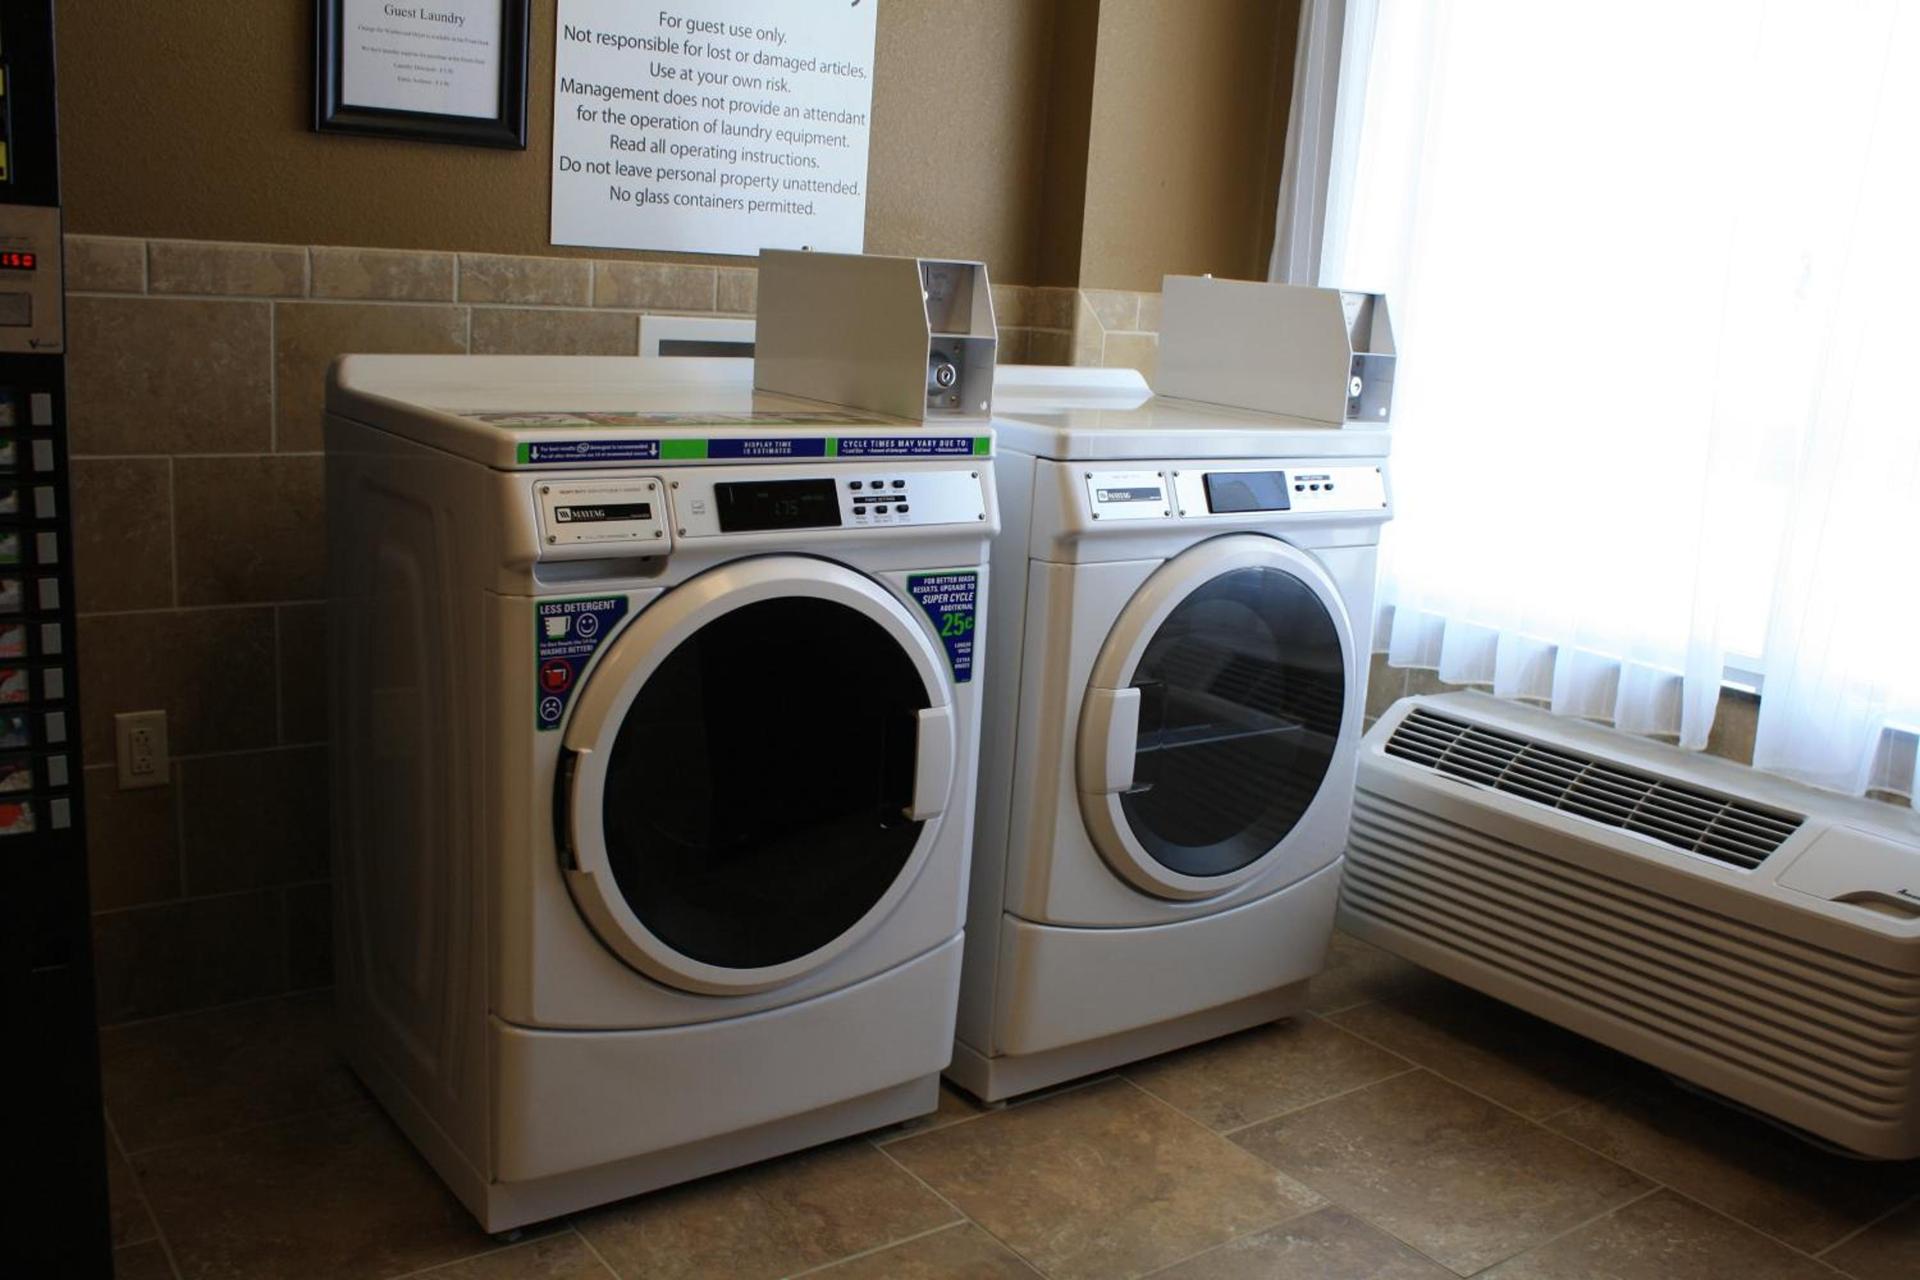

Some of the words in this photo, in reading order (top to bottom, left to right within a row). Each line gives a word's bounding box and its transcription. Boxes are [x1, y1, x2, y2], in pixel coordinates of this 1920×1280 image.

[384, 4, 416, 19] Guest
[420, 10, 466, 27] Laundry
[659, 11, 682, 28] For
[686, 19, 725, 35] guest
[729, 24, 752, 38] use
[756, 27, 787, 46] only.
[564, 25, 591, 43] Not
[596, 33, 679, 55] responsible
[683, 40, 703, 57] for
[707, 43, 731, 61] lost
[735, 51, 749, 62] or
[753, 50, 816, 73] damaged
[819, 61, 867, 79] articles.
[650, 62, 676, 79] Use
[679, 68, 693, 81] at
[698, 71, 728, 86] your
[732, 76, 761, 89] own
[766, 78, 791, 93] risk.
[560, 77, 659, 102] Management
[663, 90, 697, 106] does
[702, 96, 725, 110] not
[729, 100, 780, 117] provide
[783, 106, 799, 118] an
[803, 108, 865, 125] attendant
[577, 105, 598, 121] for
[602, 108, 626, 125] the
[630, 114, 699, 132] operation
[703, 119, 717, 133] of
[721, 121, 772, 142] laundry
[775, 129, 850, 148] equipment.
[610, 134, 646, 152] Read
[650, 139, 665, 154] all
[670, 144, 737, 164] operating
[741, 147, 820, 169] instructions.
[560, 155, 581, 172] Do
[586, 161, 611, 175] not
[615, 160, 652, 178] leave
[656, 167, 716, 183] personal
[720, 172, 779, 192] property
[783, 178, 860, 196] unattended.
[610, 185, 630, 202] No
[635, 188, 669, 207] glass
[673, 193, 744, 210] containers
[748, 199, 816, 216] permitted.
[843, 440, 867, 448] CYCLE
[871, 440, 895, 448] TIMES
[898, 440, 915, 448] MAY
[917, 440, 937, 448] VARY
[572, 510, 605, 518] MAYTAG
[936, 576, 957, 584] BETTER
[958, 575, 975, 583] WASH
[940, 584, 966, 592] UPGRADE
[540, 604, 562, 615] LESS
[564, 600, 617, 613] DETERGENT
[922, 593, 948, 605] SUPER
[949, 592, 974, 603] CYCLE
